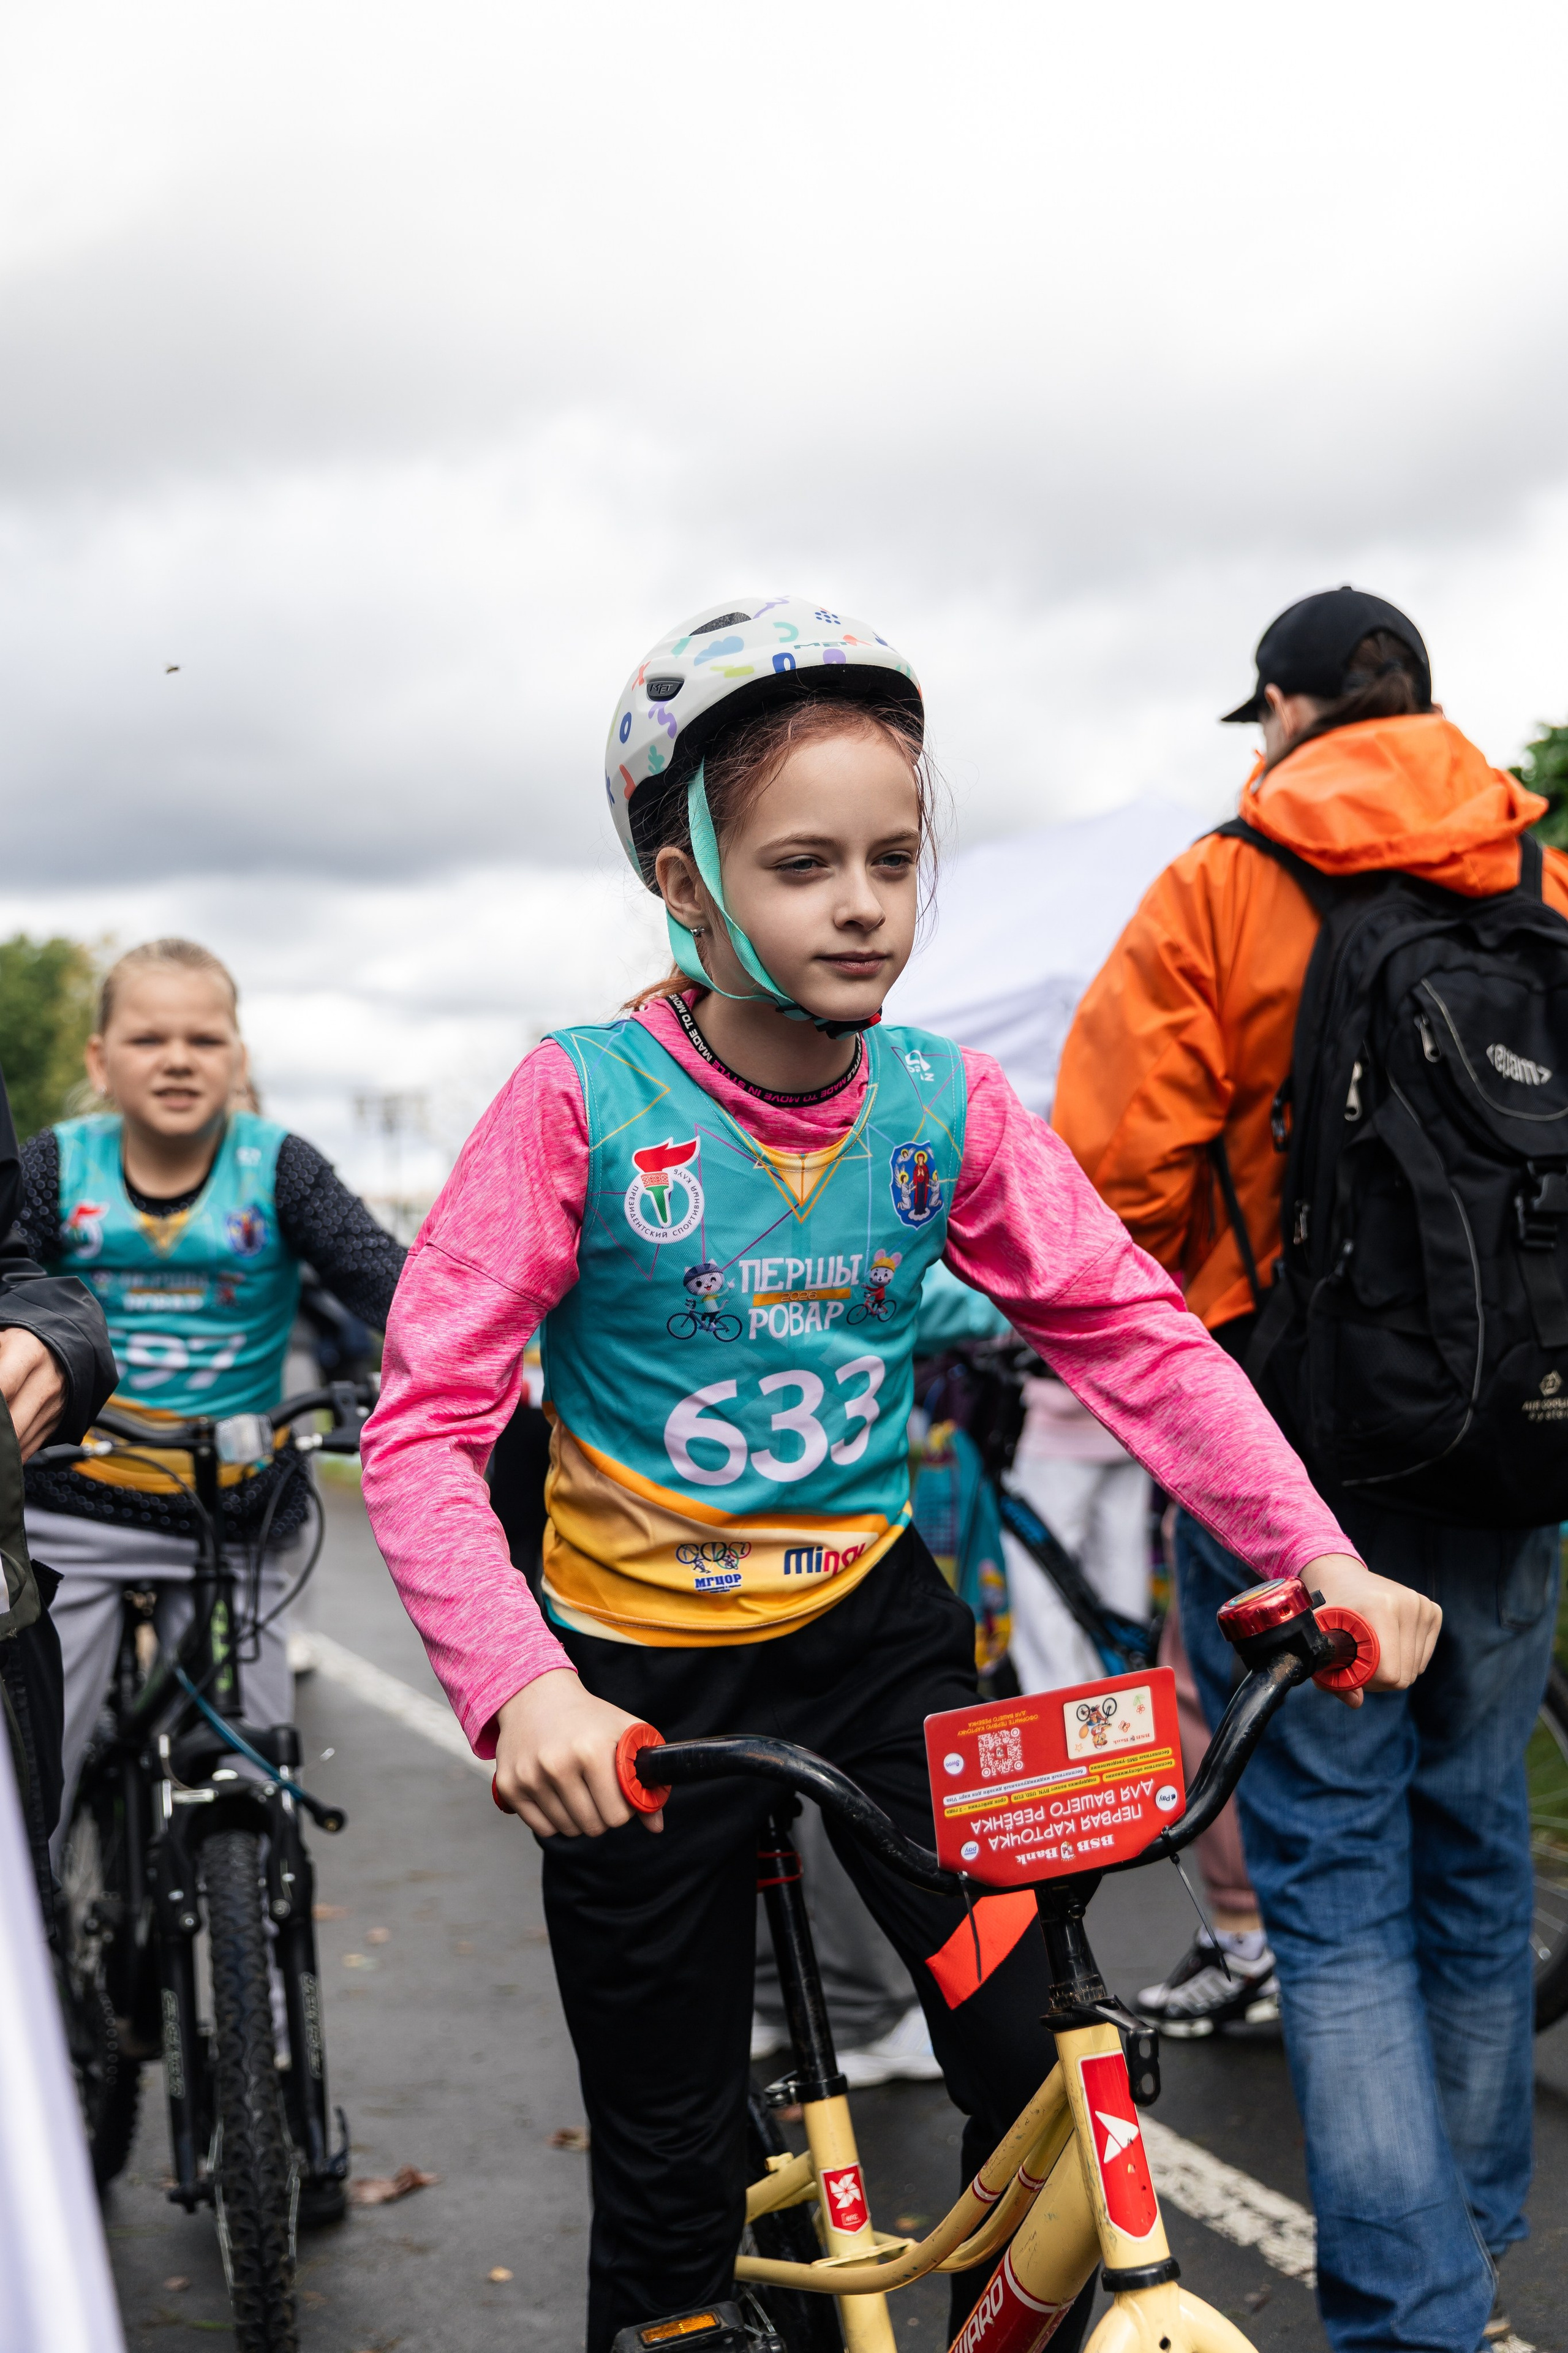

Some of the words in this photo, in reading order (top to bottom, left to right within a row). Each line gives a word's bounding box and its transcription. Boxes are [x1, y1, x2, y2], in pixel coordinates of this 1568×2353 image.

[650, 684, 673, 694] MET
[682, 1014, 695, 1029] TO
[689, 1029, 712, 1062] MADE
[712, 1060, 746, 1087] STYLE
[747, 1086, 761, 1097] IN
[820, 1077, 846, 1097] MADE
[763, 1094, 800, 1103] MOVE
[674, 1169, 692, 1184] КЛУБ
[628, 1185, 668, 1238] ПРЕЗИДЕНТСКИЙ
[673, 1185, 699, 1236] СПОРТИВНЫЙ
[739, 1254, 862, 1293] ПЕРШЫ
[781, 1291, 817, 1302] 2026
[748, 1302, 844, 1340] РОВАР
[664, 1355, 886, 1486] 633
[695, 1574, 742, 1588] МГЦОР
[986, 1720, 1007, 1730] ПЕРВУЮ
[993, 1713, 1013, 1723] ВАШЕГО
[1008, 1714, 1038, 1725] ОФОРМИТЕ
[957, 1726, 984, 1736] КАРТОЧКУ
[1139, 1750, 1169, 1759] бесплатные
[1090, 1756, 1138, 1770] SMS-уведомления
[1144, 1761, 1172, 1770] бесплатное
[1051, 1769, 1083, 1780] бесплатный
[1106, 1768, 1142, 1778] обслуживание
[1003, 1776, 1050, 1791] индивидуальный
[1068, 1778, 1096, 1788] поддержка
[1120, 1778, 1154, 1801] ДЛЯ
[983, 1786, 1002, 1796] дизайн
[968, 1800, 993, 1810] действия
[1050, 1789, 1115, 1817] ВАШЕГО
[970, 1805, 1045, 1834] РЕБЁНКА
[1080, 1803, 1142, 1830] ПЕРВАЯ
[988, 1819, 1075, 1850] КАРТОЧКА
[1077, 1834, 1114, 1851] BSB
[1015, 1846, 1058, 1865] Bank
